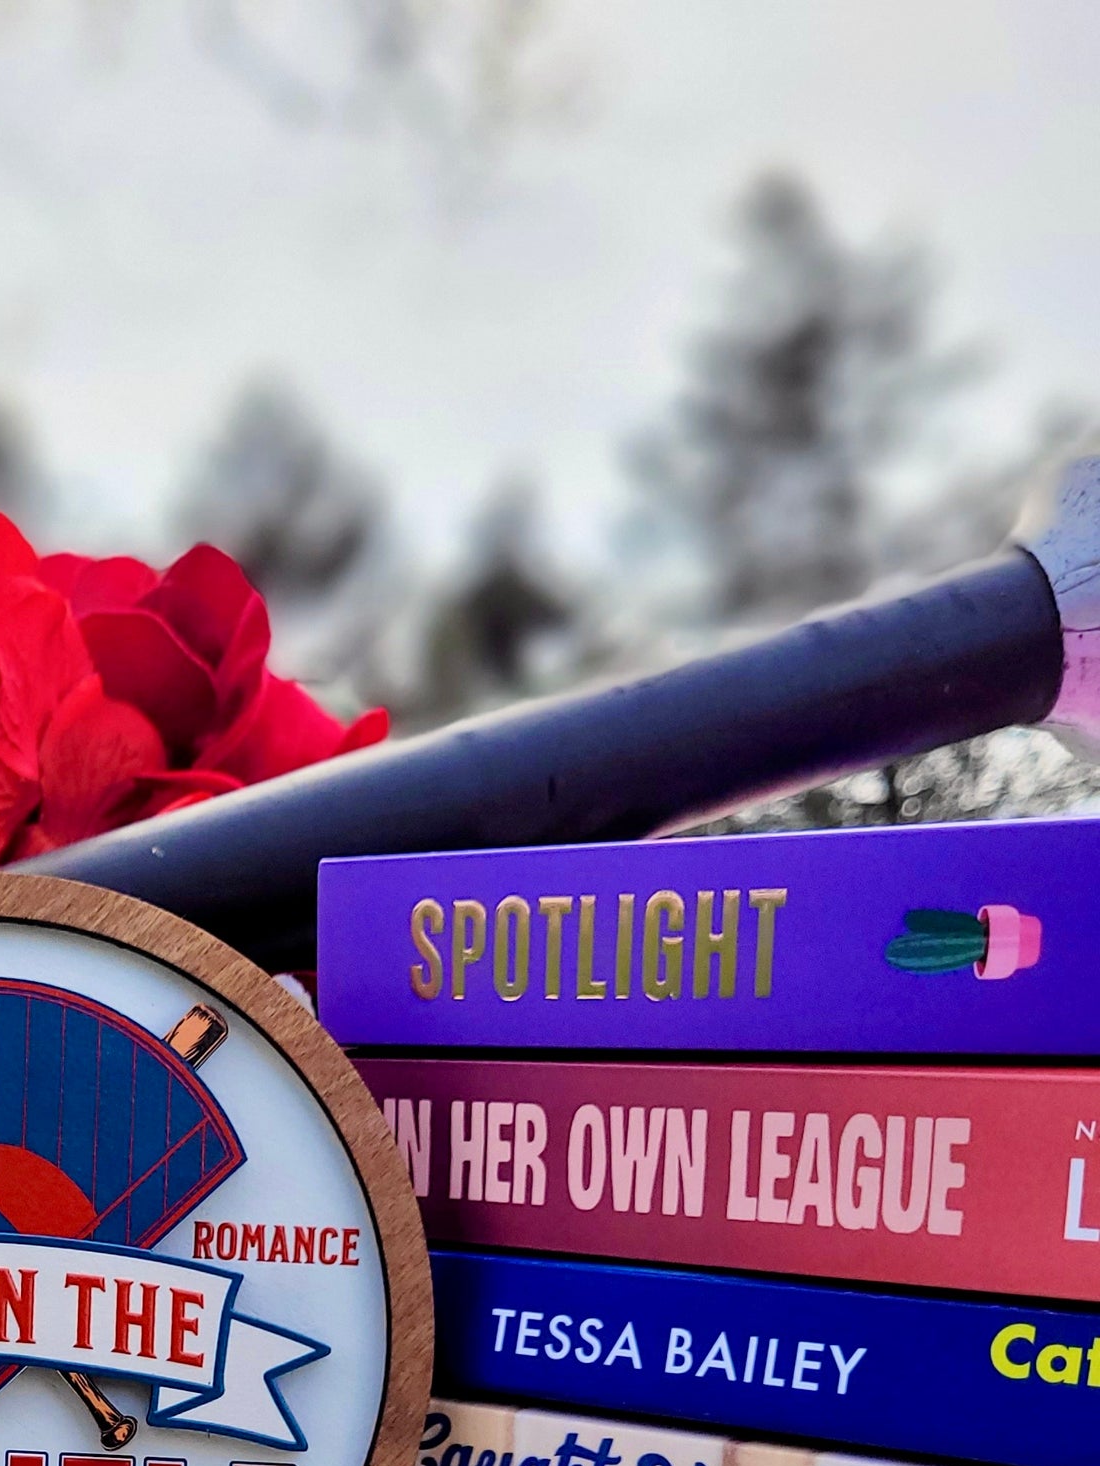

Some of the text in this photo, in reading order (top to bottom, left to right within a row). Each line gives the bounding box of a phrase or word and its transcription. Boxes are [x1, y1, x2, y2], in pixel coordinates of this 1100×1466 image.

[410, 888, 788, 1002] SPOTLIGHT
[449, 1100, 548, 1206] HER
[567, 1104, 708, 1218] OWN
[726, 1110, 972, 1236] LEAGUE
[193, 1221, 360, 1266] ROMANCE
[64, 1272, 206, 1368] THE
[491, 1308, 868, 1395] TESSA BAILEY
